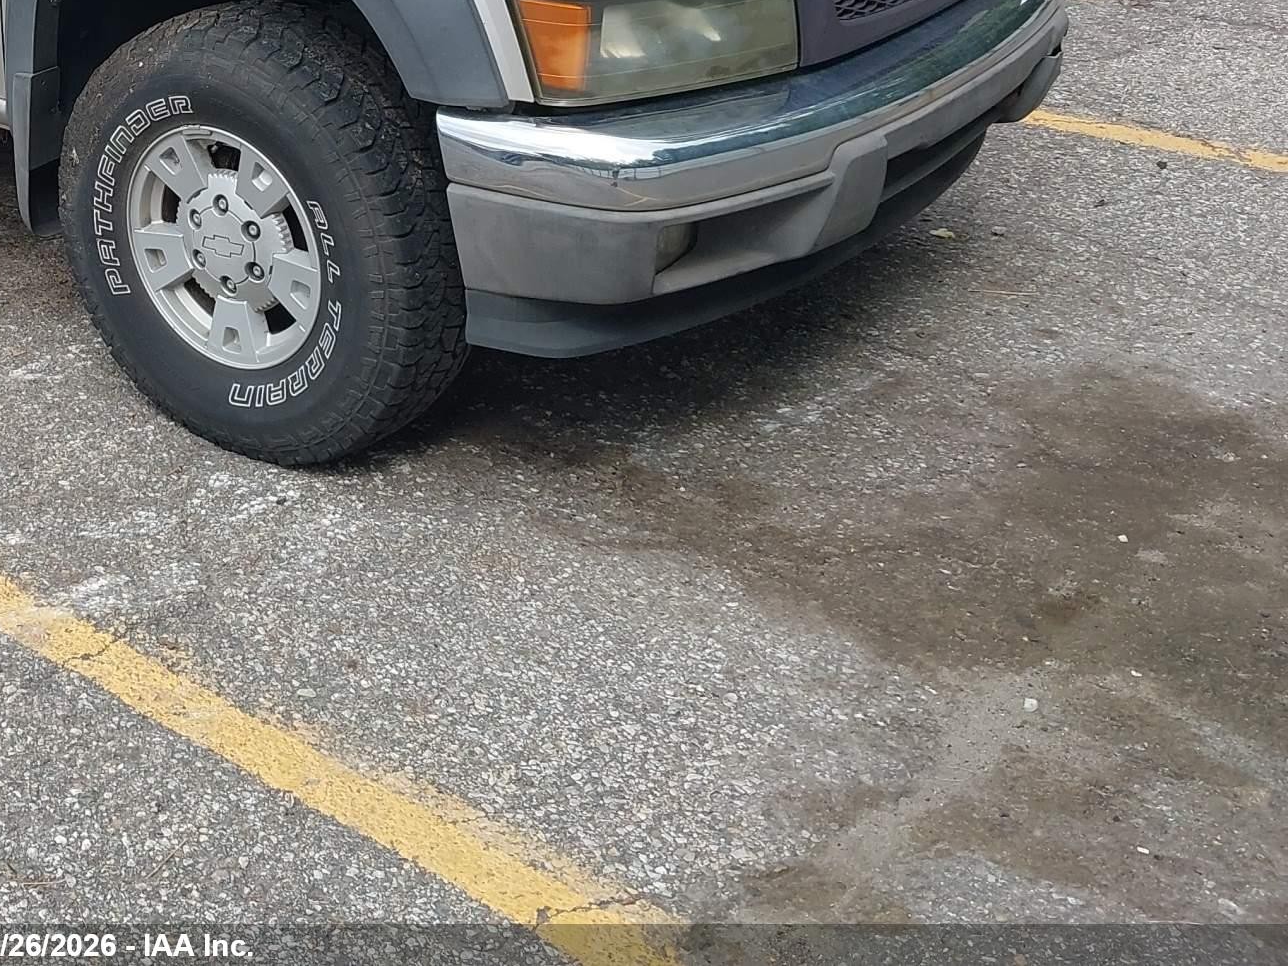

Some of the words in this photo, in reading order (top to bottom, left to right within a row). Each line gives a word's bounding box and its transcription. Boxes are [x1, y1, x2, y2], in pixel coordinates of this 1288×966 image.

[93, 95, 194, 295] PATHFINDER
[306, 200, 341, 283] ALL
[228, 300, 342, 408] TERRAIN
